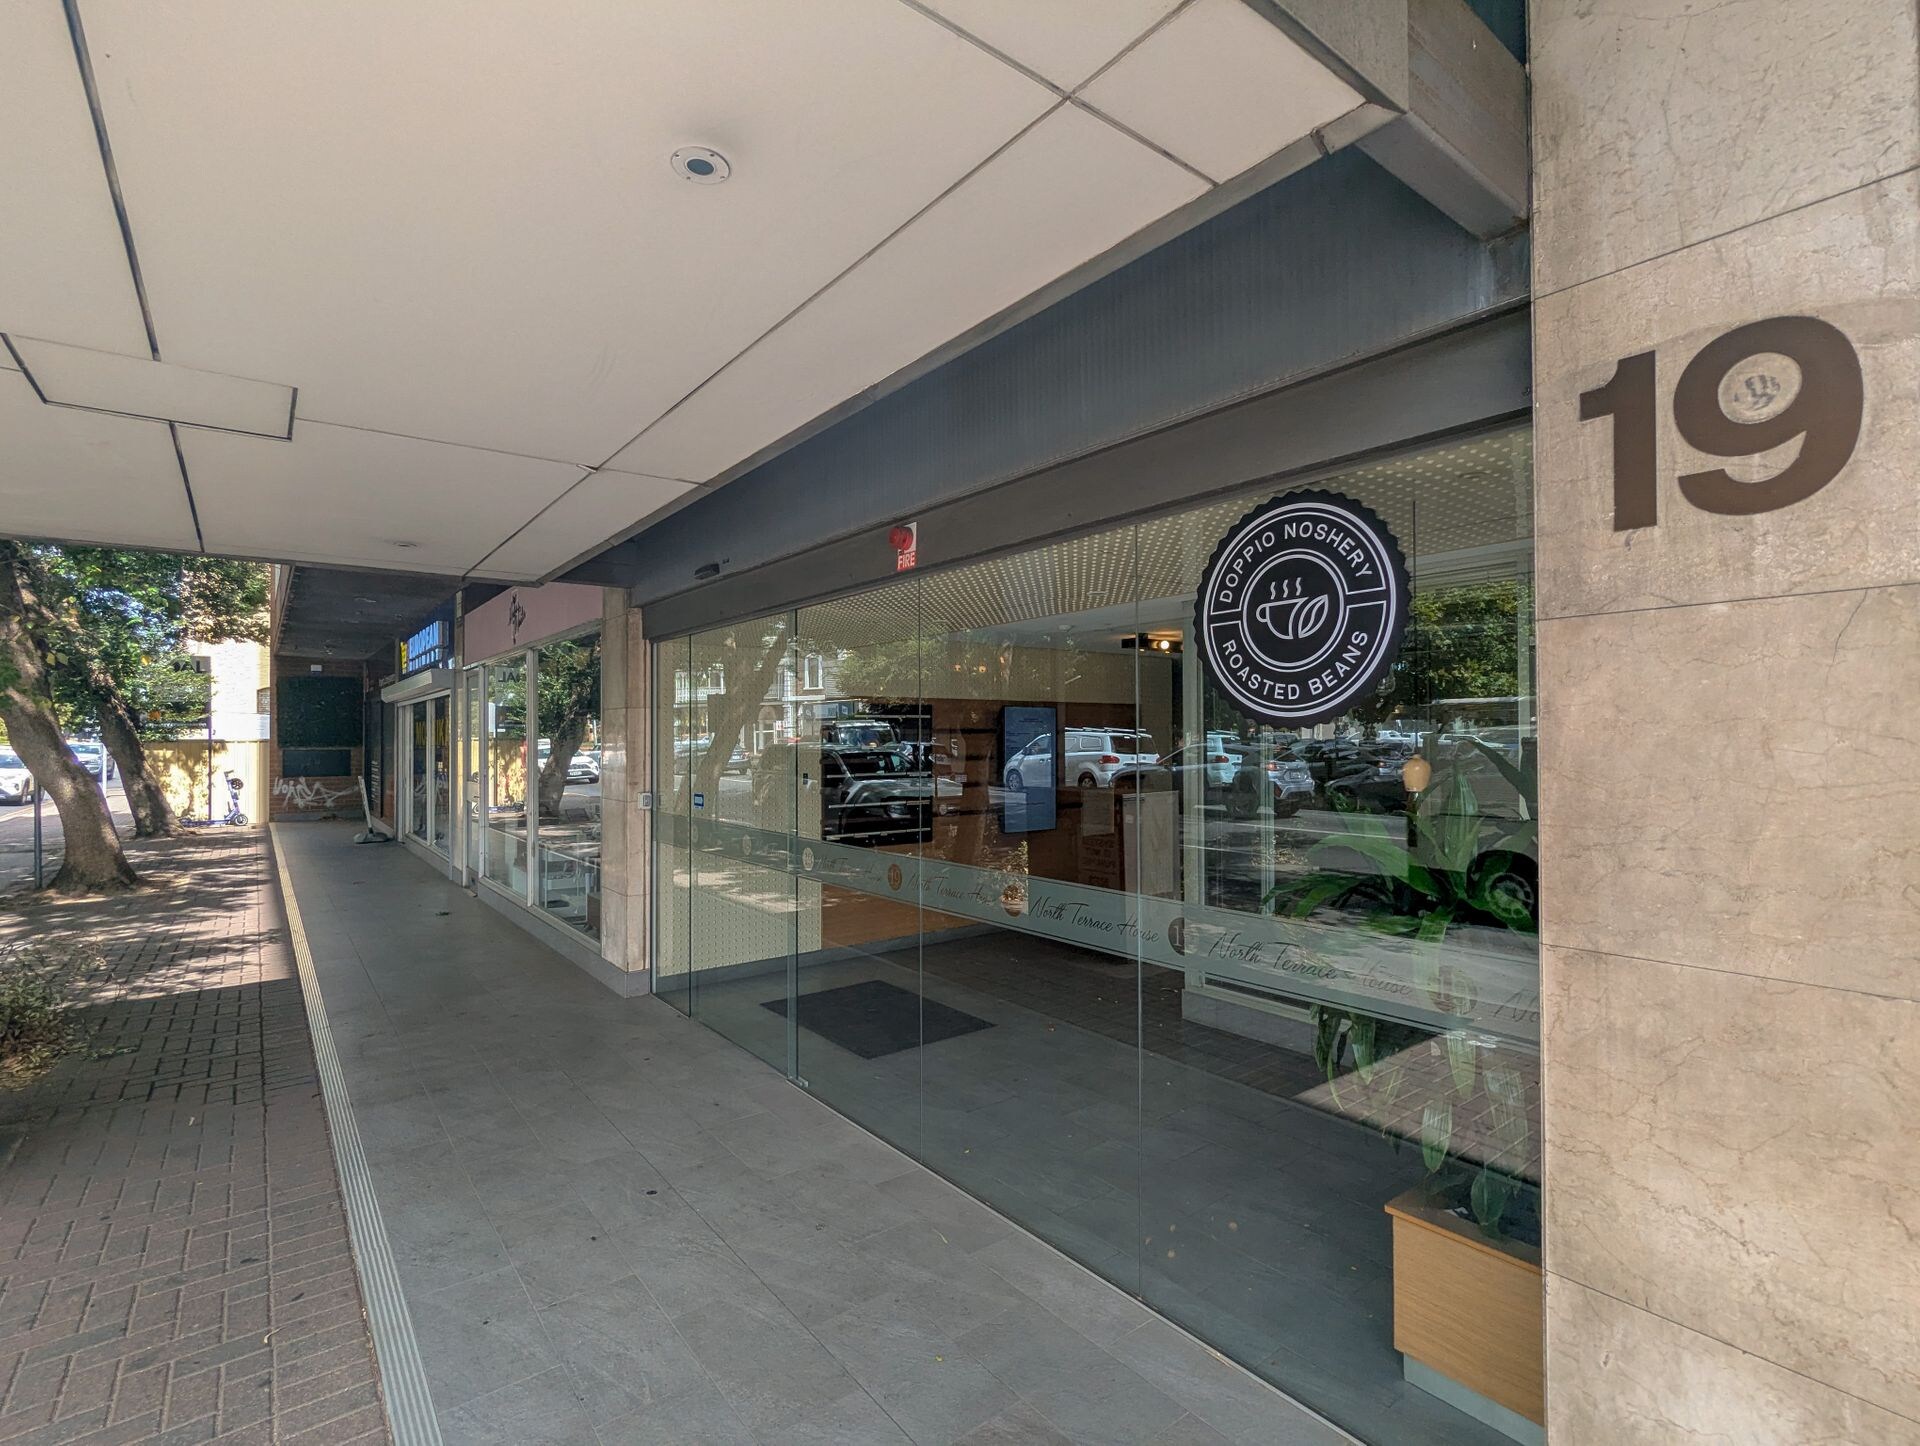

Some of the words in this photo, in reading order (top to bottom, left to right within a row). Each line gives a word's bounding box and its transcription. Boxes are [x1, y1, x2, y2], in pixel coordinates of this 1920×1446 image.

[1579, 315, 1864, 532] 19
[897, 551, 916, 569] FIRE
[1219, 531, 1275, 603] DOPPIO
[1284, 521, 1373, 578] NOSHERY
[1222, 639, 1300, 700] ROASTED
[1308, 631, 1368, 696] BEANS
[1029, 895, 1066, 921] North
[1067, 902, 1114, 933] Terrace
[1117, 912, 1160, 943] House
[1208, 931, 1263, 963] North
[1269, 941, 1338, 980] Terrace
